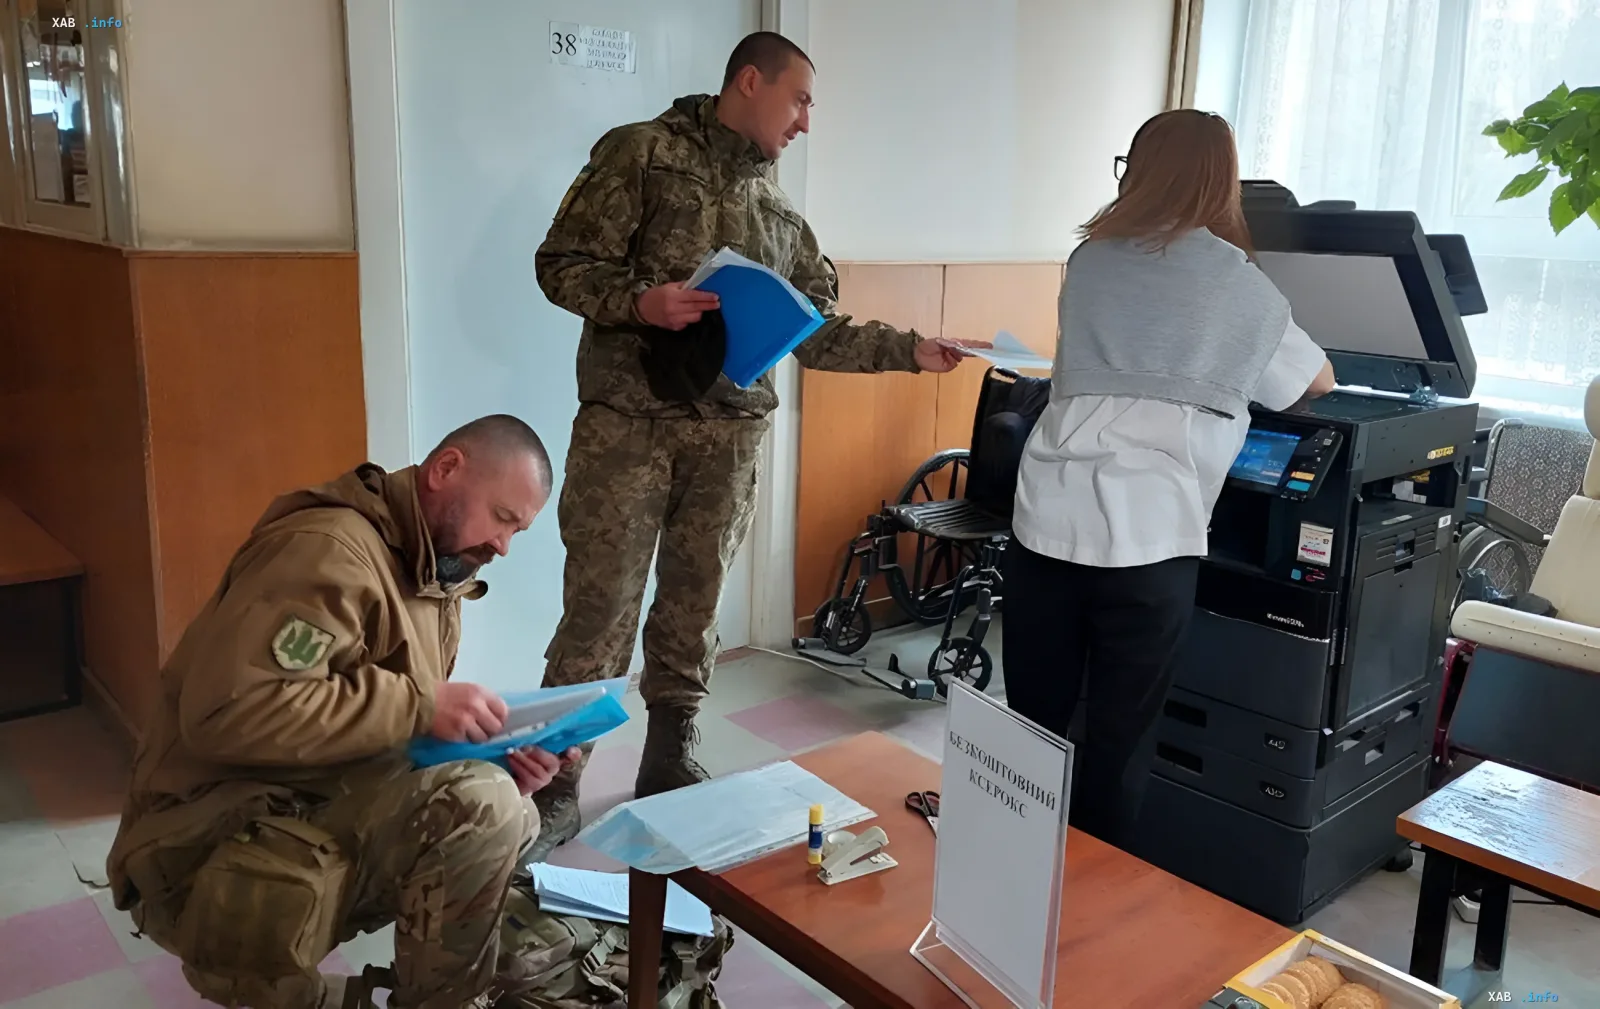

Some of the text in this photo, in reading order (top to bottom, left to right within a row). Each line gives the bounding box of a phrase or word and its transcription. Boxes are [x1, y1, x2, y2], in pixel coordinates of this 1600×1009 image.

[552, 32, 577, 56] 38
[949, 730, 1056, 811] БЕЗКОШТОВНИЙ
[969, 768, 1028, 818] КСЕРОКС
